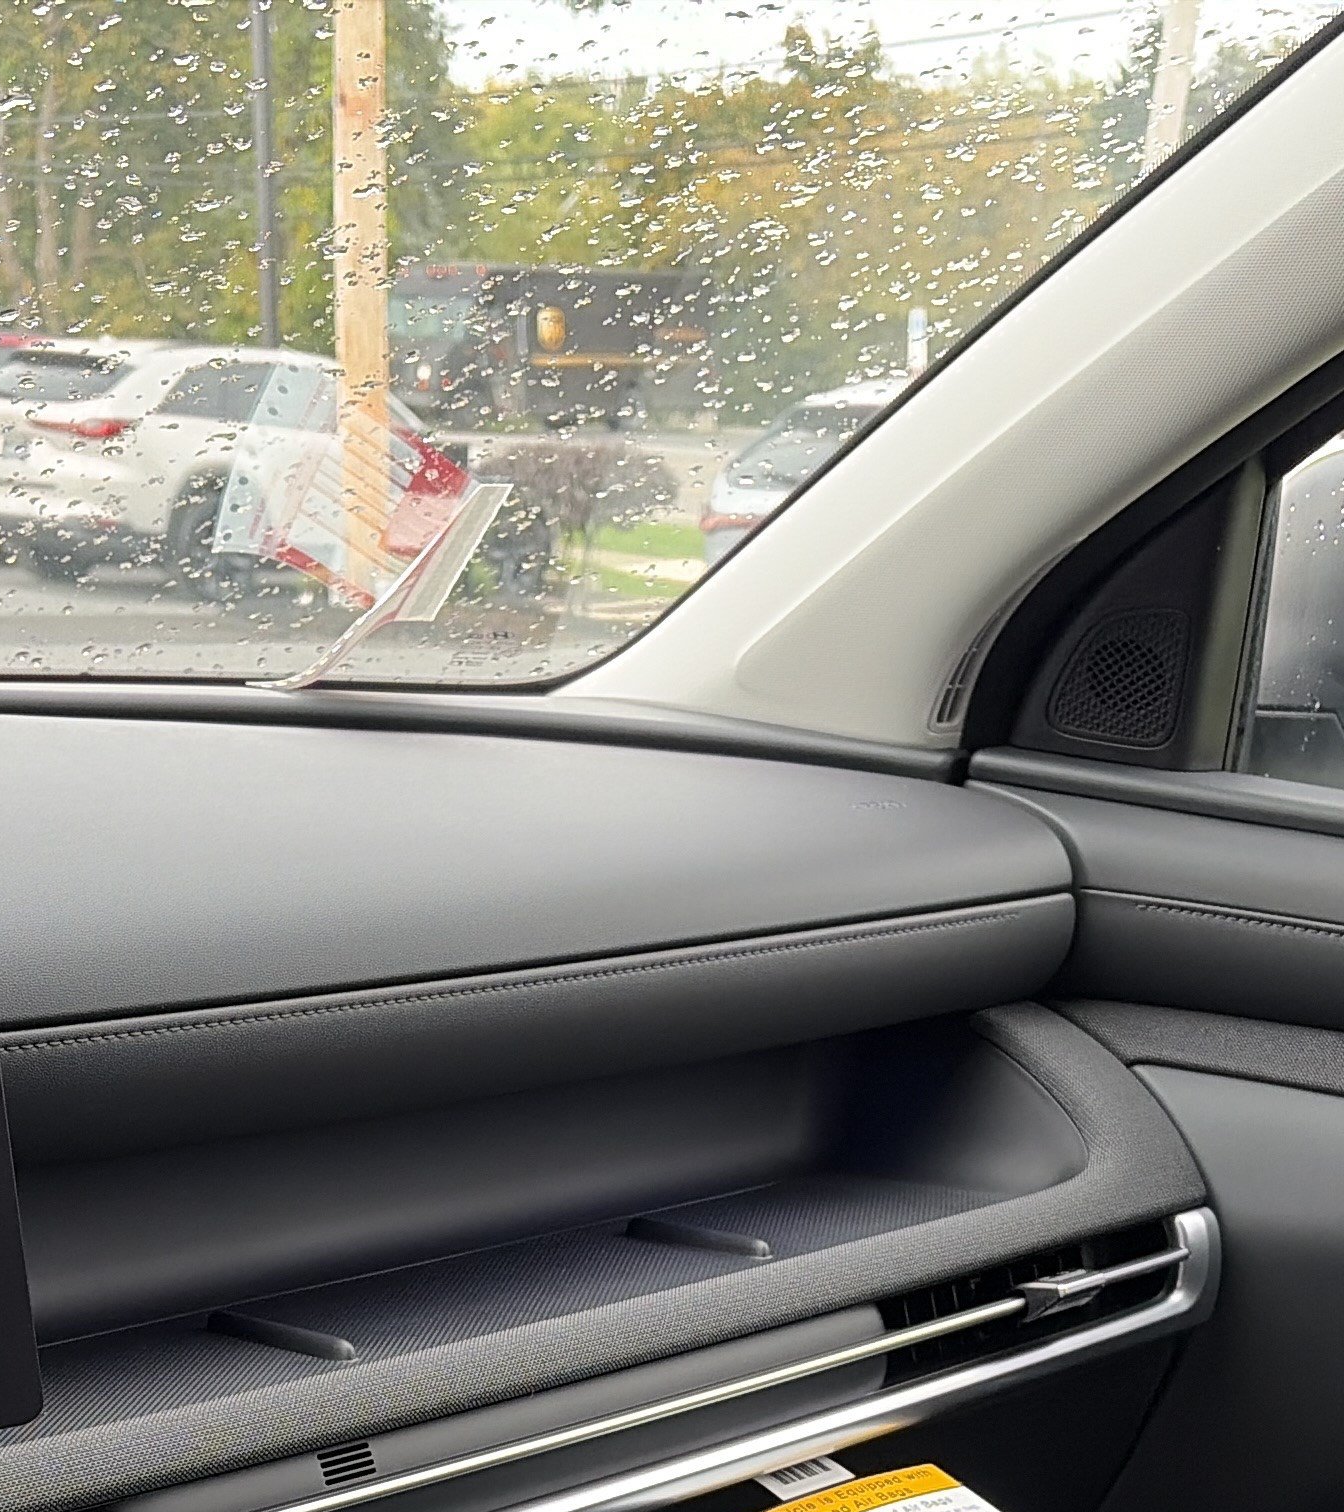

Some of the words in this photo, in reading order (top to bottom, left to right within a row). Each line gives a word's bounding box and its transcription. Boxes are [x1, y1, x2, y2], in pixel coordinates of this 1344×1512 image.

[834, 1475, 902, 1500] Equipped
[907, 1470, 932, 1480] with
[856, 1497, 872, 1509] Air
[875, 1488, 913, 1501] Bags
